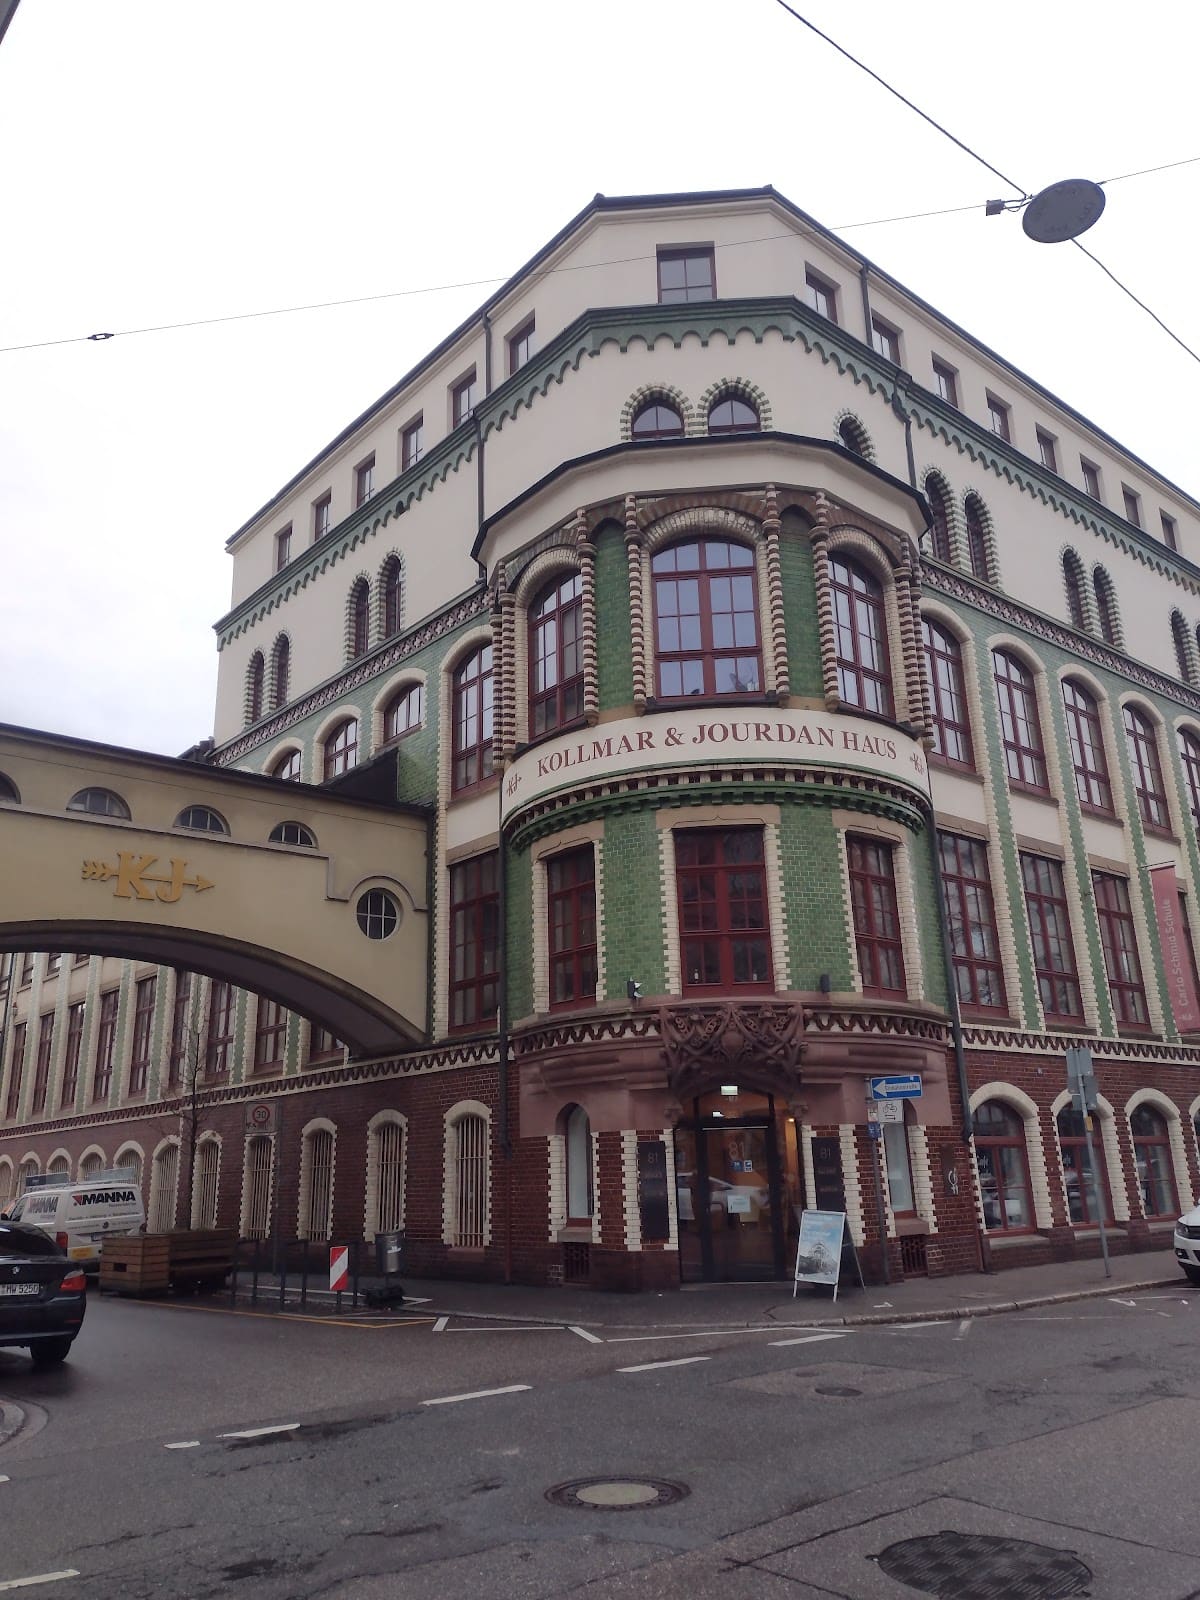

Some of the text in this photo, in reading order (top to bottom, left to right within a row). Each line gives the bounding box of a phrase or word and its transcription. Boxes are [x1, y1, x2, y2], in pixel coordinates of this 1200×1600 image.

[536, 722, 898, 778] KOLLMAR & JOURDAN HAUS
[113, 851, 188, 903] KJ
[1162, 899, 1189, 1006] Carlo Schmid Schule
[256, 1110, 267, 1119] 30
[647, 1152, 659, 1164] 81
[729, 1142, 745, 1160] 81
[820, 1147, 831, 1160] 81
[82, 1191, 136, 1205] MANNA
[18, 1283, 39, 1294] 5250
